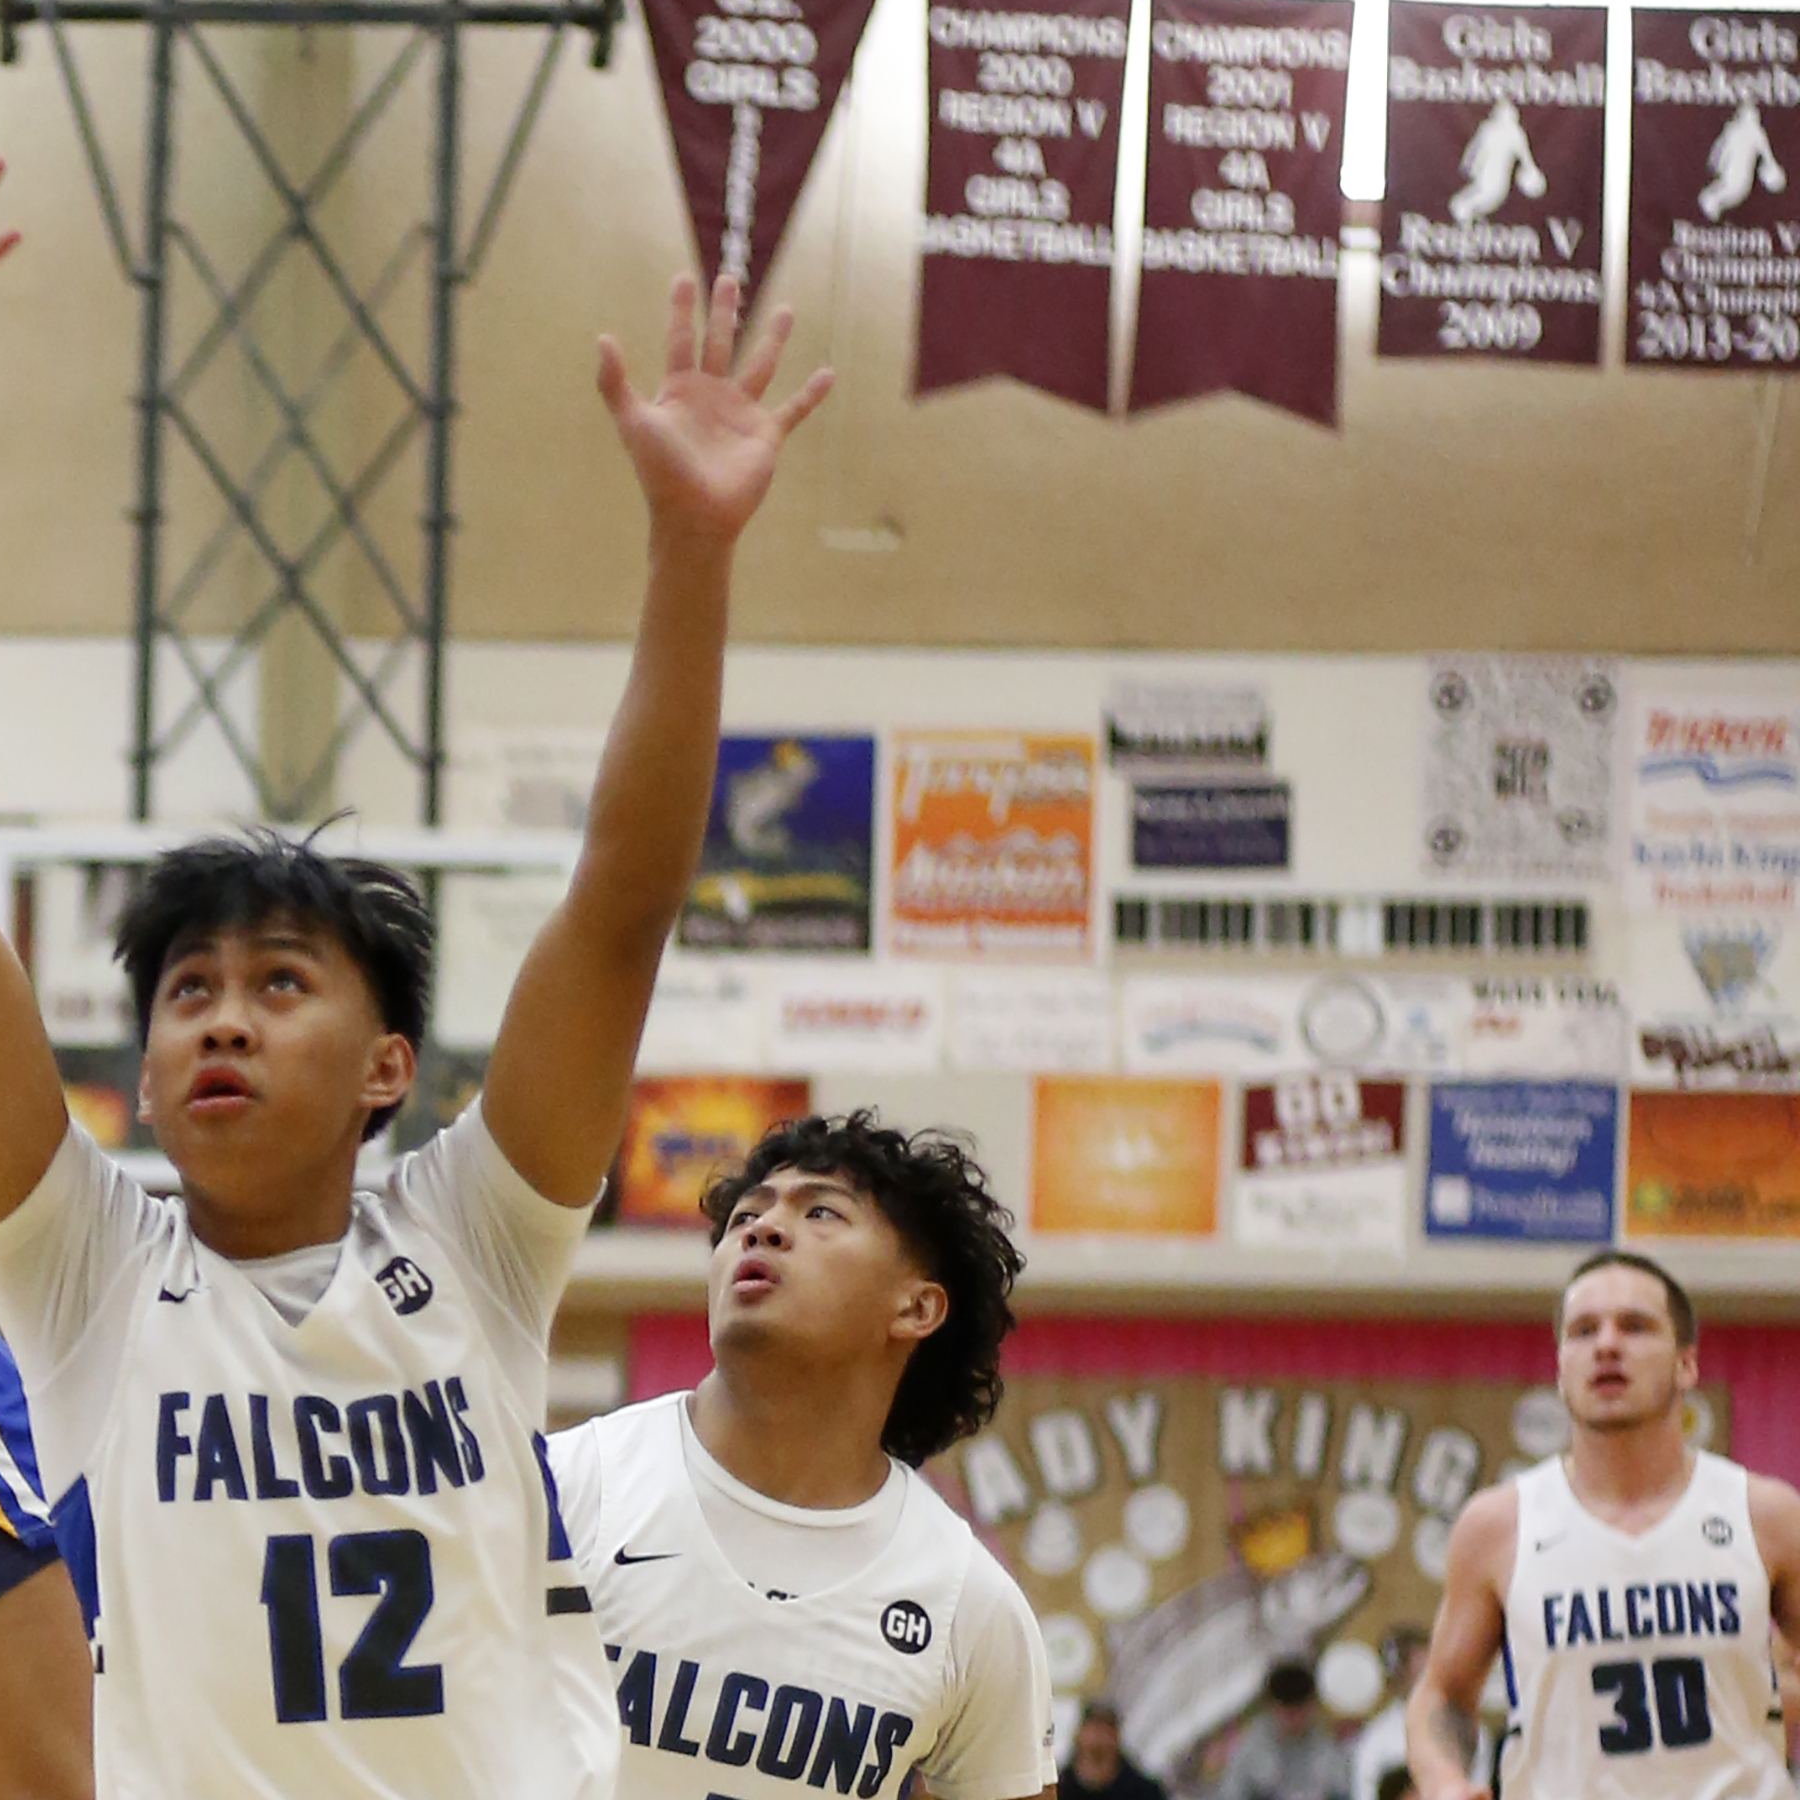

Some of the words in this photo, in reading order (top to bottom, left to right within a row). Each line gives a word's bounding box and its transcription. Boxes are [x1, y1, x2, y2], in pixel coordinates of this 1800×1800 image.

[929, 6, 1128, 59] CHAMPIONS
[1152, 20, 1349, 70] CHAMPIONS
[1442, 14, 1552, 61] Girls
[1688, 16, 1798, 63] Girls
[684, 58, 820, 112] GIRLS
[1390, 56, 1605, 107] Basketball
[938, 88, 1072, 139] REGION
[1075, 98, 1108, 140] V
[1163, 101, 1297, 151] REGION
[1301, 110, 1331, 152] V
[964, 172, 1071, 223] GIRLS
[1190, 187, 1295, 235] GIRLS
[1400, 212, 1541, 260] Region
[1547, 215, 1583, 261] V
[1381, 252, 1603, 304] Champions
[156, 1376, 485, 1502] FALCONS
[962, 1391, 1160, 1527] ADY
[1217, 1388, 1516, 1510] KING
[260, 1529, 444, 1724] 12
[884, 1608, 928, 1647] GH
[1543, 1581, 1741, 1653] FALCONS
[606, 1644, 913, 1800] ALCONS
[1591, 1656, 1713, 1755] 30
